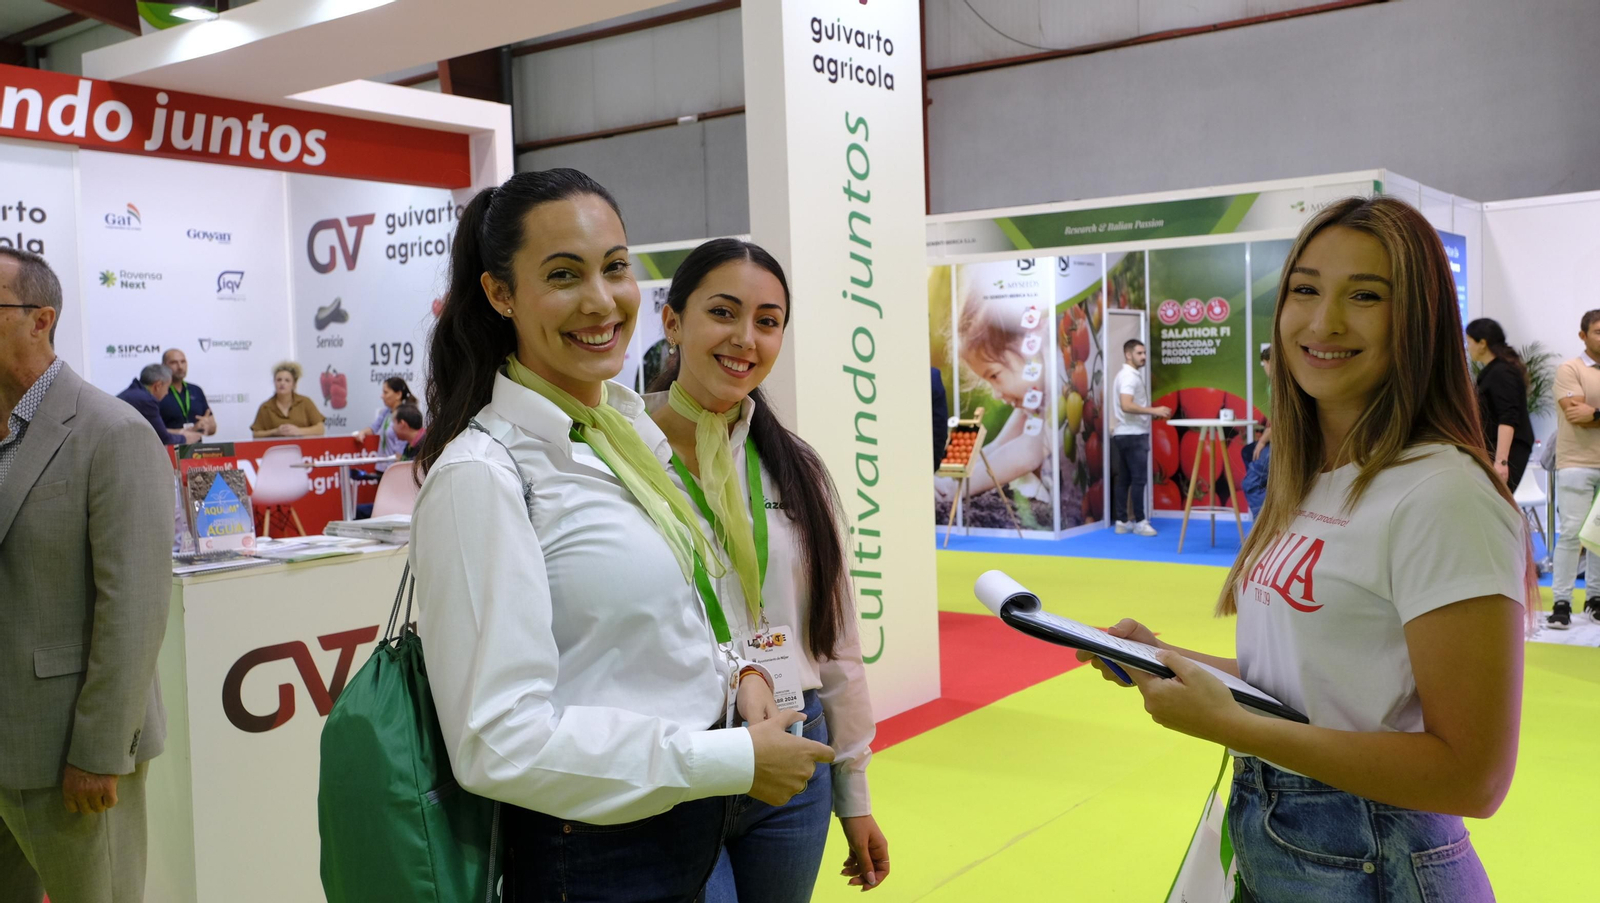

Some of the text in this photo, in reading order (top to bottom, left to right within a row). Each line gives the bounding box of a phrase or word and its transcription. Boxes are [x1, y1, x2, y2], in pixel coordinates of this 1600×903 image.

[810, 16, 894, 56] guivarto
[1, 79, 327, 166] ndo juntos
[2, 200, 47, 225] rto
[386, 201, 464, 235] guivarto
[842, 111, 883, 319] juntos
[186, 228, 231, 242] Gowan
[1064, 223, 1097, 235] Research
[1107, 220, 1133, 231] Italian
[1134, 218, 1164, 229] Passion
[386, 233, 451, 264] agricol
[120, 270, 162, 281] Rovensa
[121, 280, 146, 289] Next
[316, 335, 344, 348] Servicio
[1161, 327, 1218, 339] SALATHOR
[118, 344, 160, 353] SIPCAM
[1161, 338, 1221, 349] PRECOCIDAD Y
[370, 342, 413, 366] 1979
[1161, 356, 1192, 365] UNIDAS
[324, 413, 347, 430] apidez
[207, 523, 245, 536] AGUA
[1240, 530, 1325, 613] ALLA
